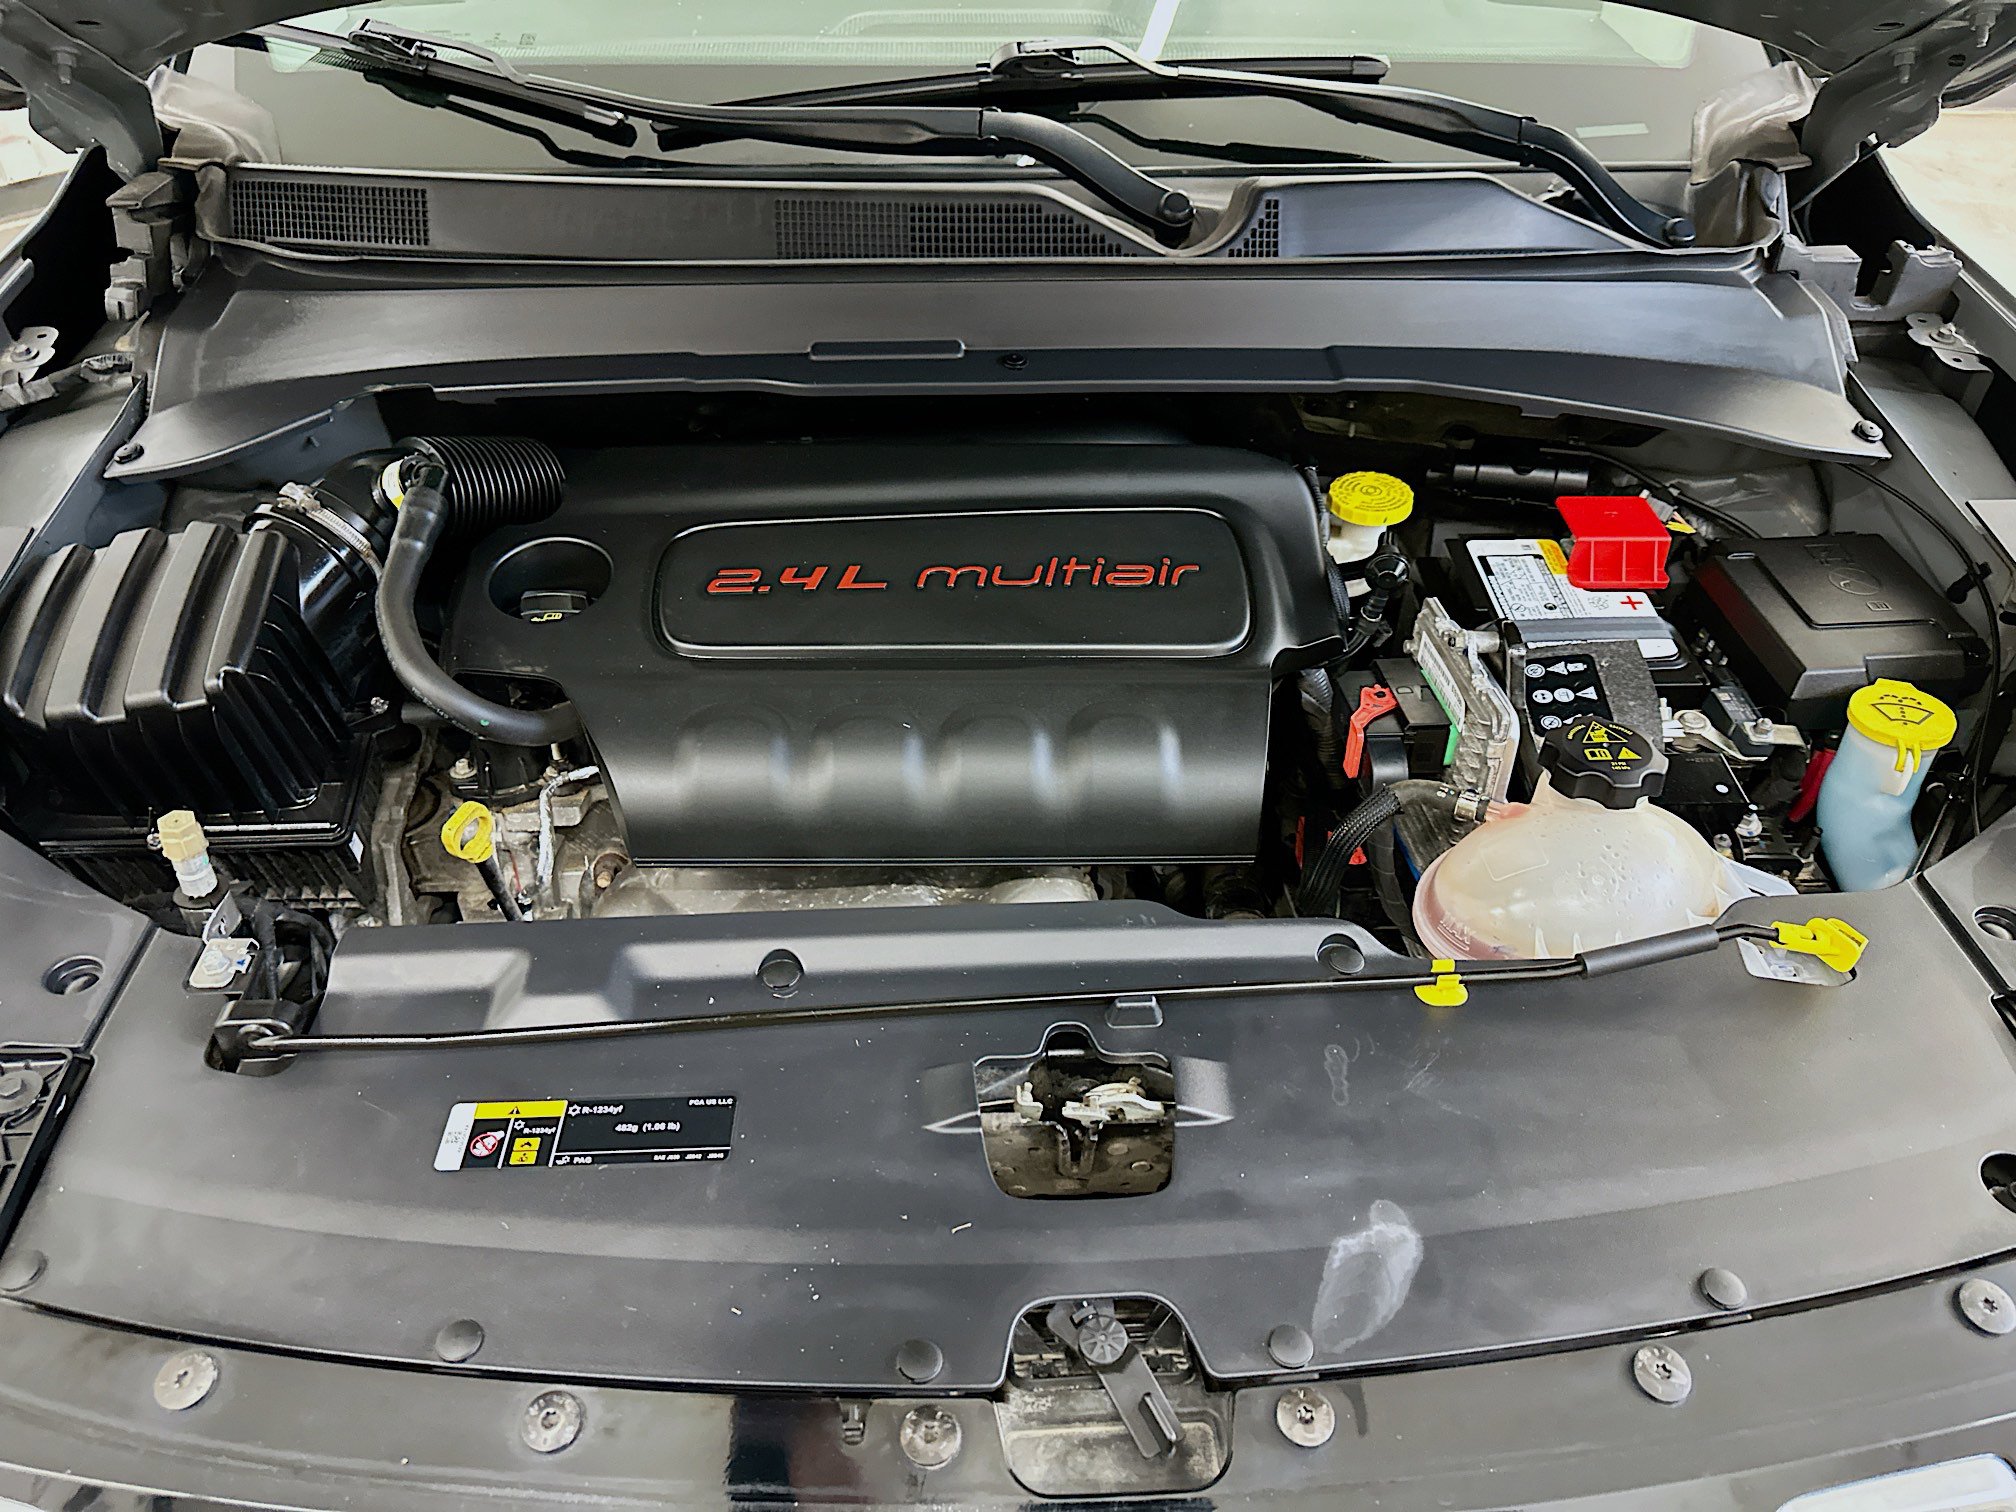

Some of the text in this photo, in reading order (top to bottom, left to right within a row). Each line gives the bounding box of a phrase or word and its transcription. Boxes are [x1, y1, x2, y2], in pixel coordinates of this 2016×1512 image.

[916, 556, 1200, 590] multiair
[718, 1097, 734, 1105] LLC
[581, 1104, 624, 1115] R-1234yf
